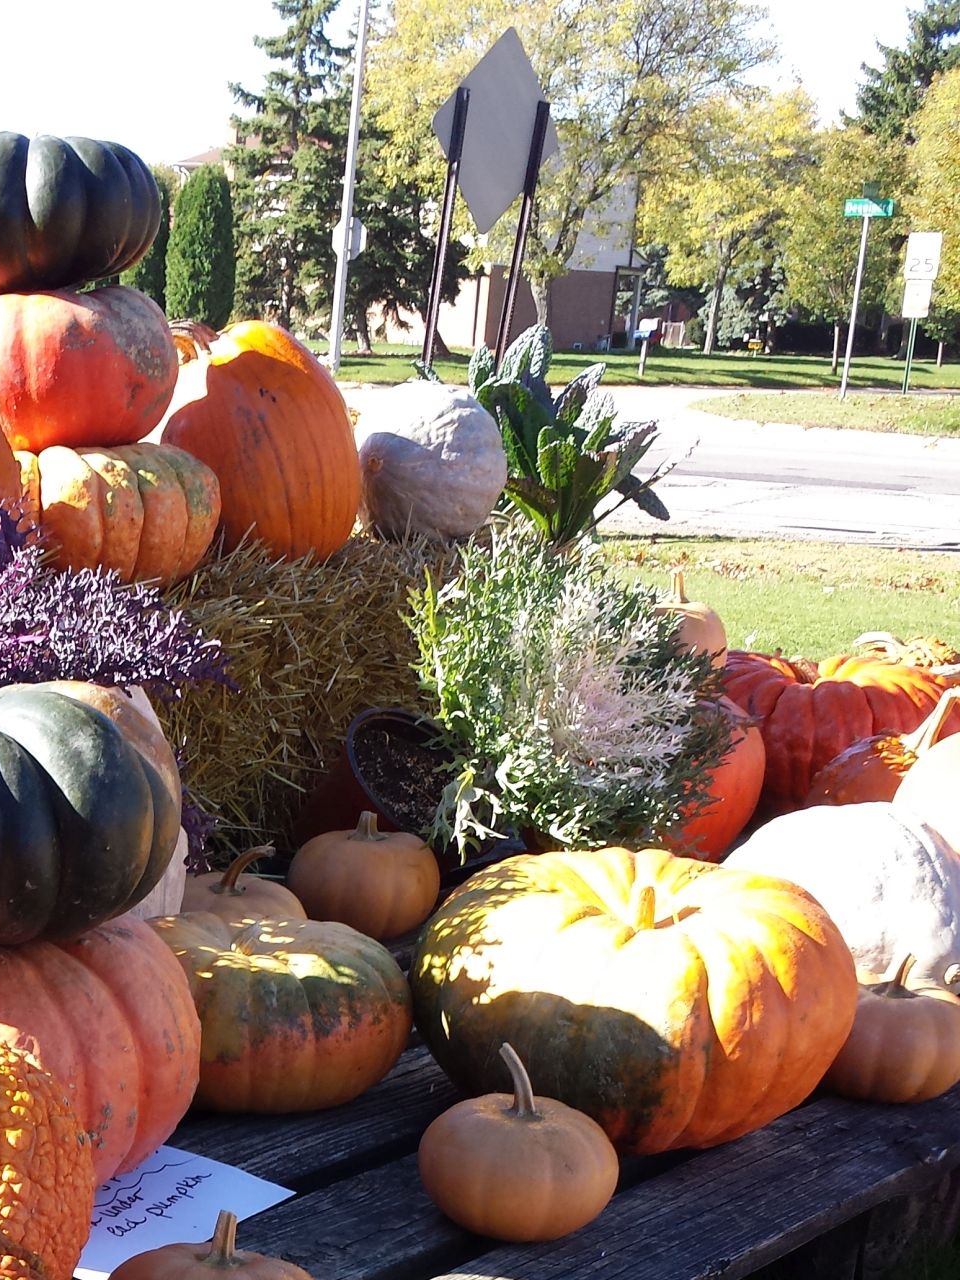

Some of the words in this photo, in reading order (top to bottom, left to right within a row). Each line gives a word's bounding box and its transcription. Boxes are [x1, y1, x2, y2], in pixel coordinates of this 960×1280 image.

[909, 258, 934, 273] 25
[99, 1187, 144, 1217] under
[145, 1173, 213, 1219] pumpkin
